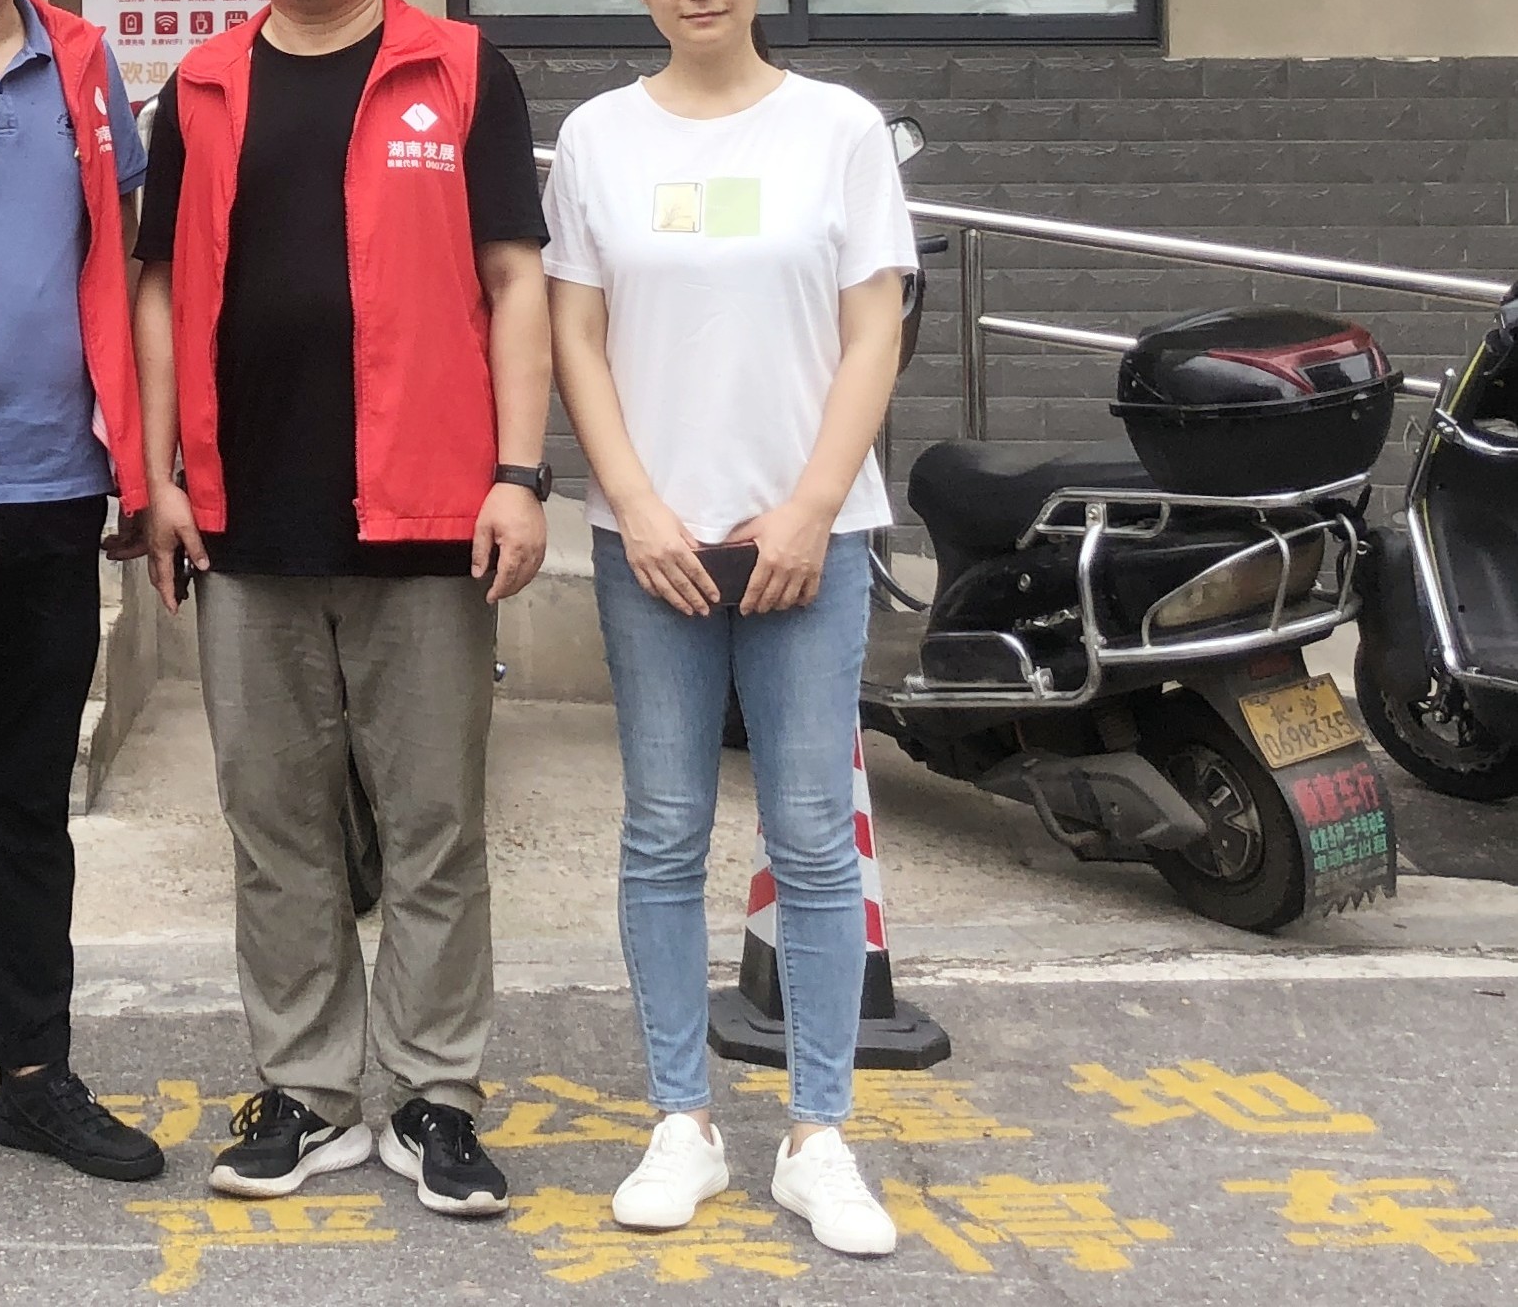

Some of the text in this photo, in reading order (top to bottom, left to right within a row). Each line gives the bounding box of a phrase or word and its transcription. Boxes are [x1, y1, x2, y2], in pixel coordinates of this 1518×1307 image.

[120, 61, 179, 85] 欢迎
[386, 140, 455, 162] 湖南发展
